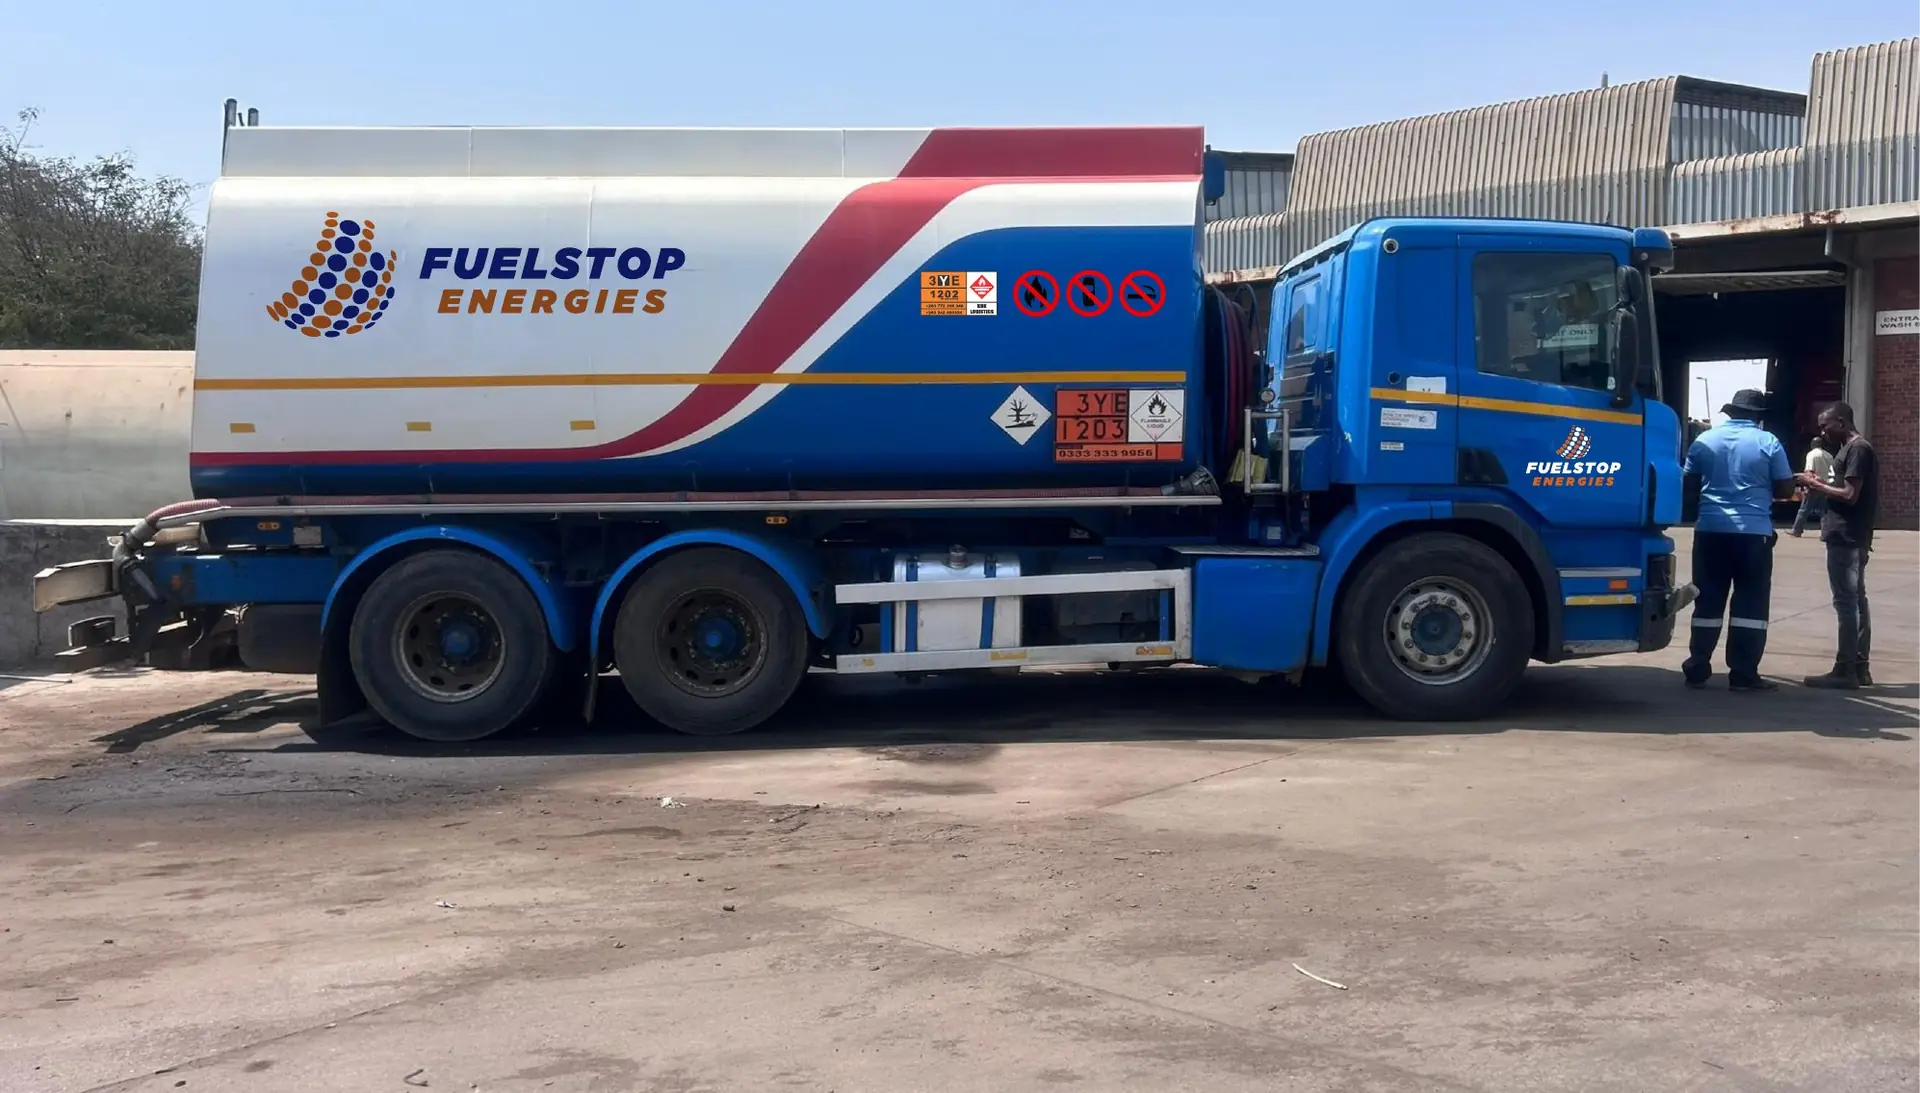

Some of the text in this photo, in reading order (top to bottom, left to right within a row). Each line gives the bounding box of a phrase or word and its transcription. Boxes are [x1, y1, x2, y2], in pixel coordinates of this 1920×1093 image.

[419, 247, 686, 280] FUELSTOP
[929, 275, 960, 286] 3YE
[930, 290, 959, 298] 1202
[437, 289, 668, 314] ENERGIES
[1077, 393, 1126, 413] 3YE
[1062, 419, 1124, 440] 1203
[1094, 449, 1118, 457] 333
[1525, 462, 1622, 475] FUELSTOP
[1532, 476, 1615, 487] ENERGIES
